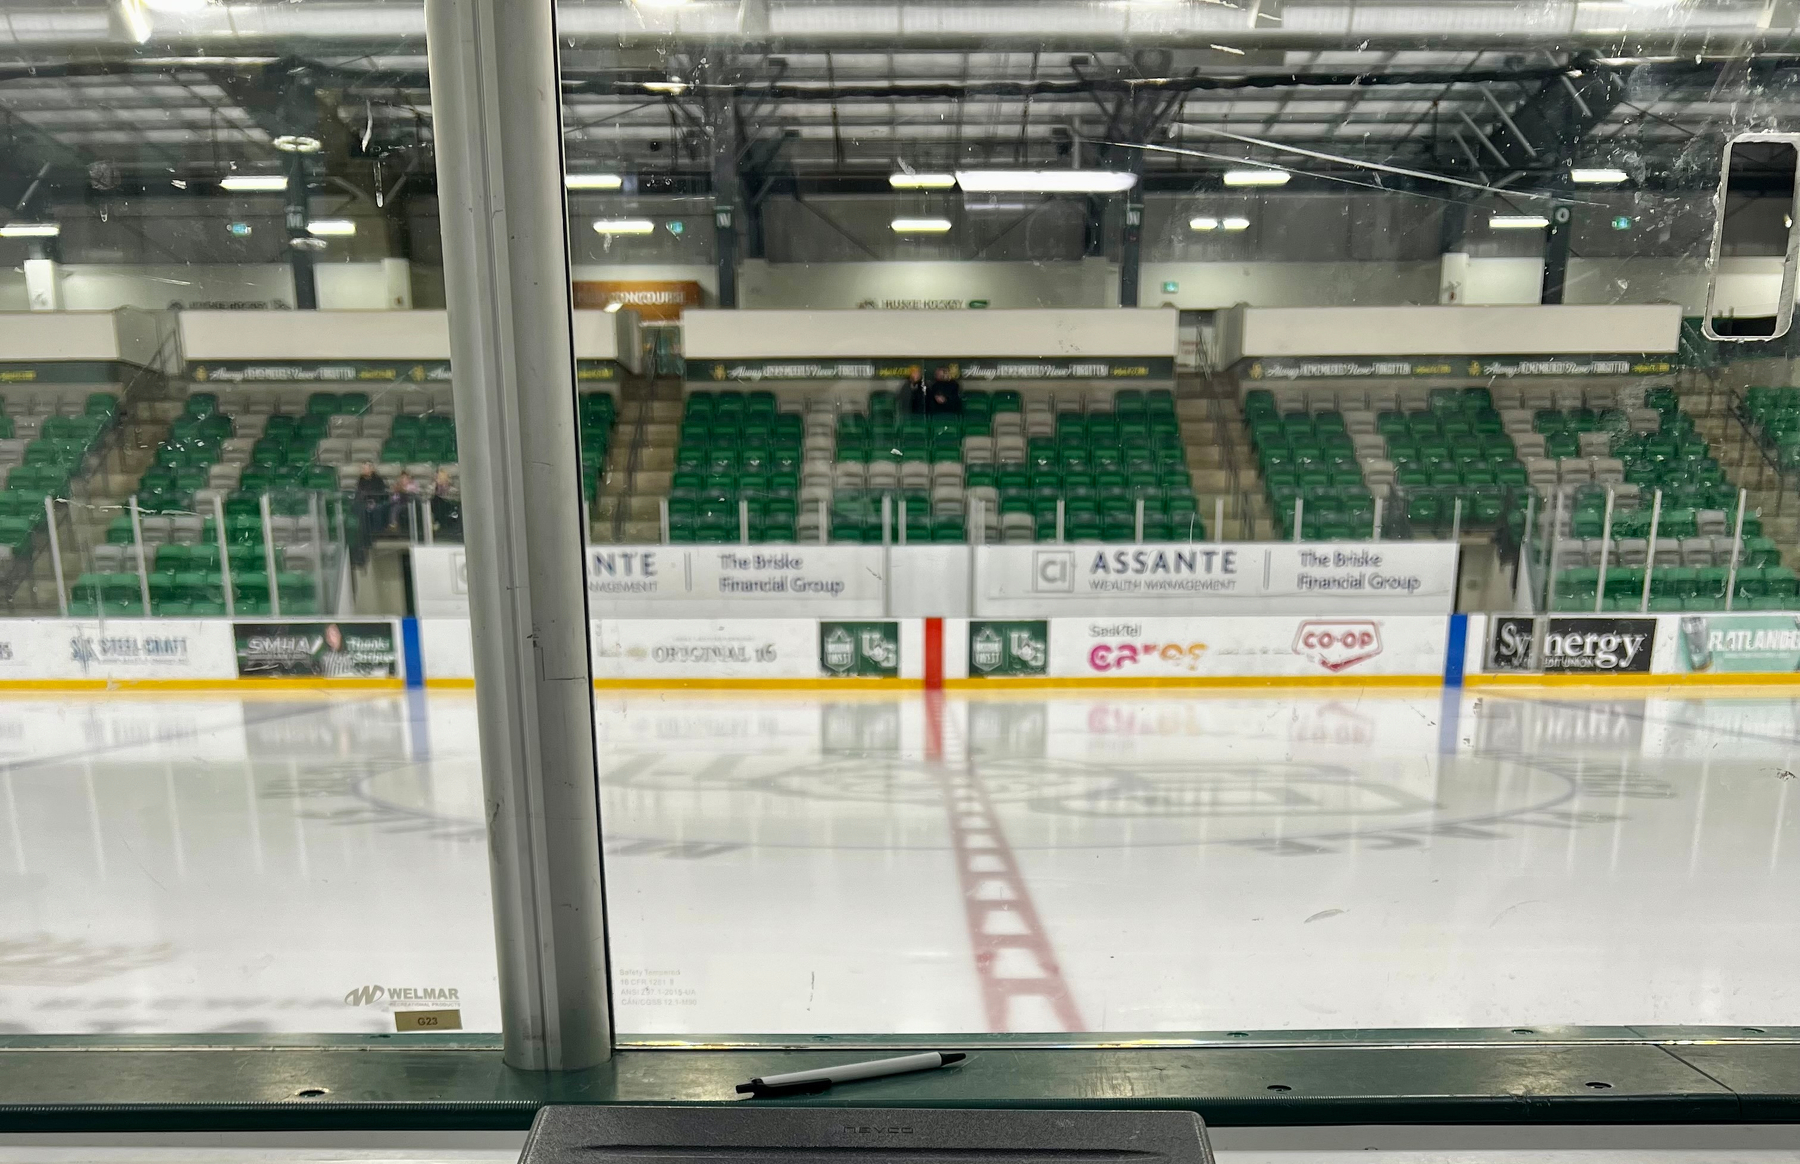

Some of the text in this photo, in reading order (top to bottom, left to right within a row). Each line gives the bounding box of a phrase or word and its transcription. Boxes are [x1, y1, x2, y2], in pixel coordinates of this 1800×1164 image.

[717, 552, 750, 569] The
[1089, 550, 1237, 575] ASSANTE
[1300, 551, 1383, 567] The Briske
[718, 576, 845, 596] Financial Group
[1297, 573, 1421, 593] Financial Group
[1302, 631, 1374, 649] CO-OP
[1500, 621, 1646, 669] Synergy
[388, 988, 459, 1000] WELMAR
[417, 1017, 438, 1026] G23
